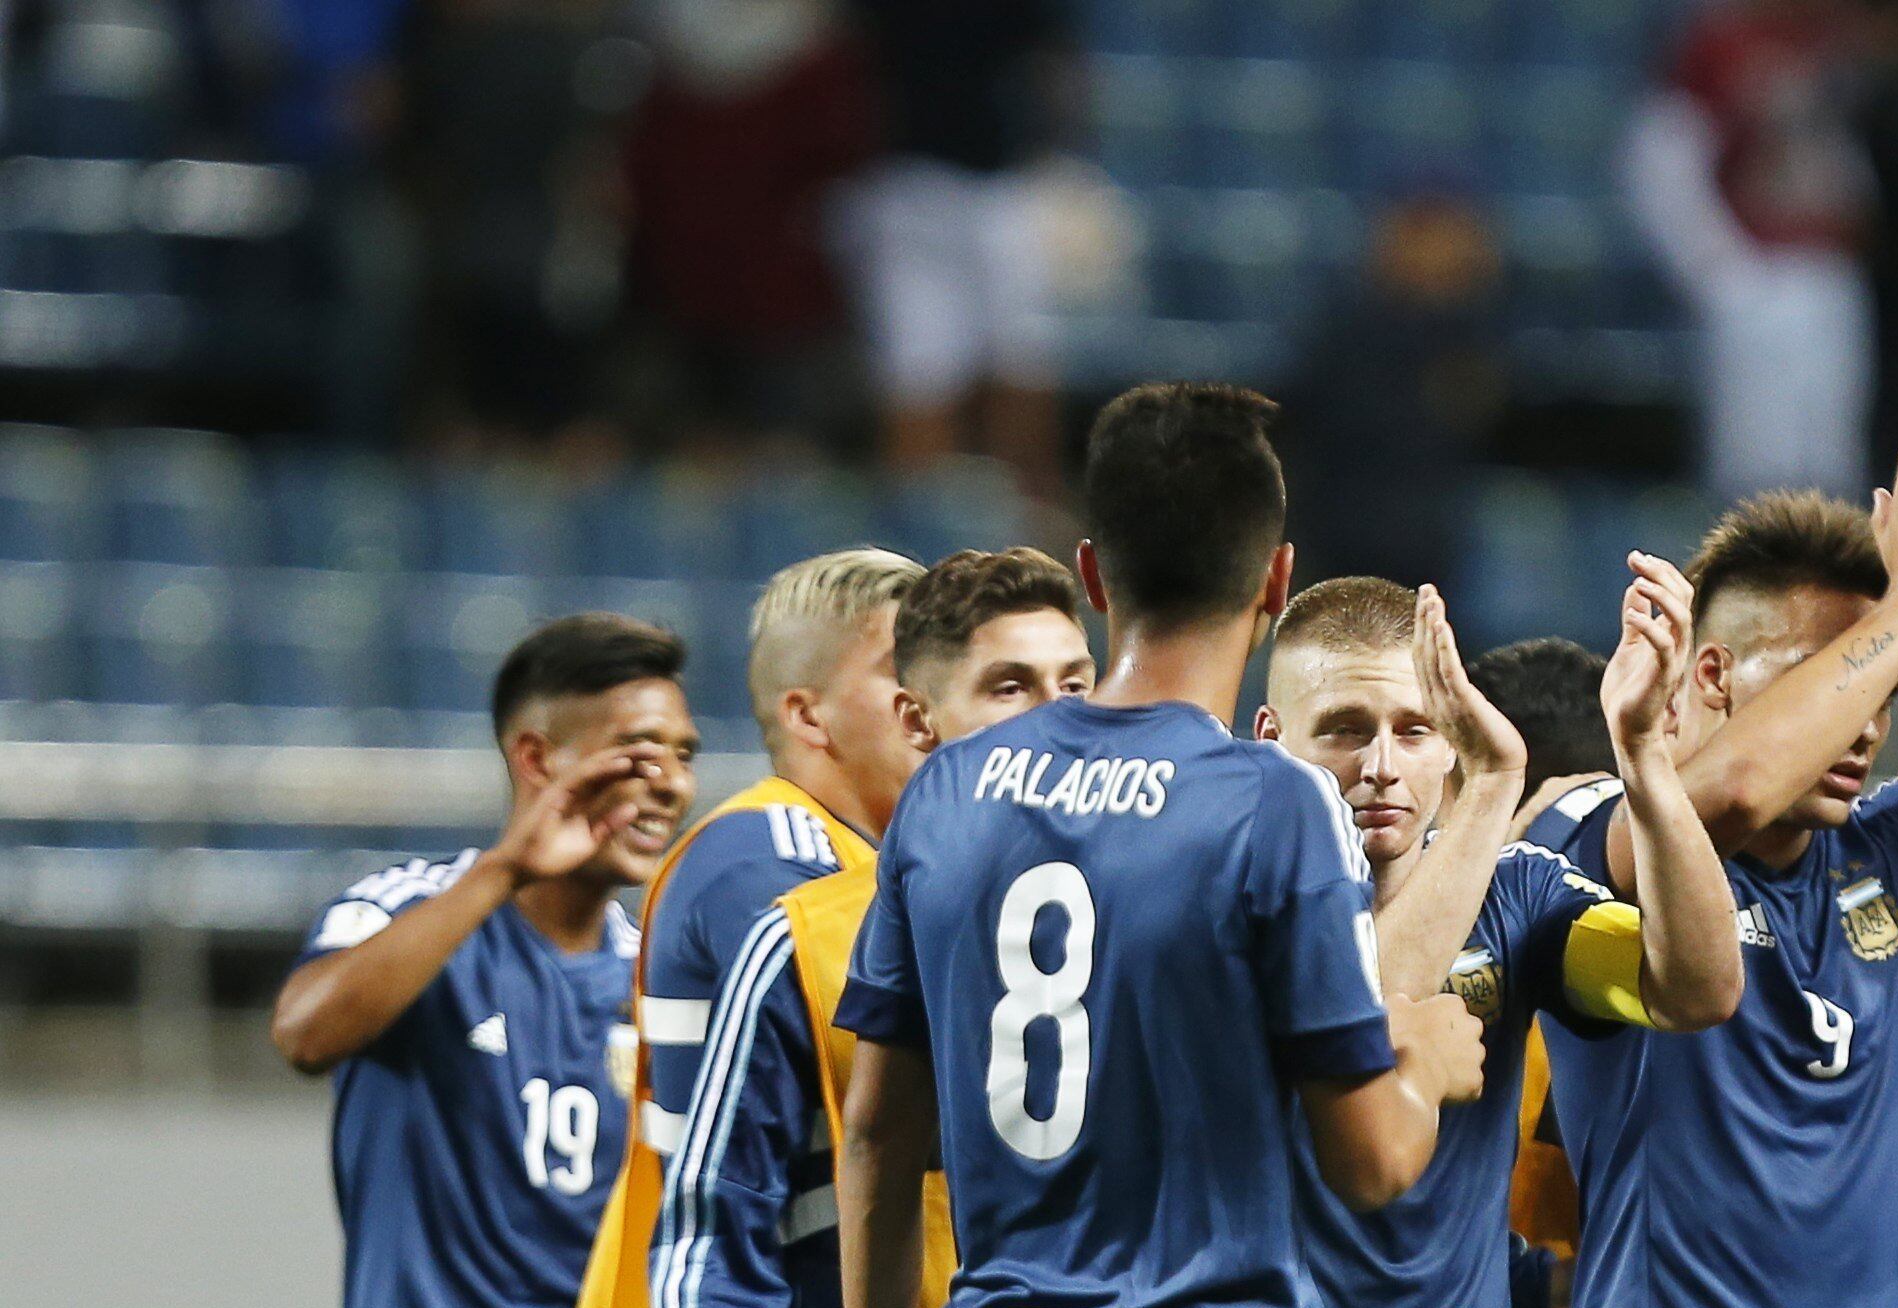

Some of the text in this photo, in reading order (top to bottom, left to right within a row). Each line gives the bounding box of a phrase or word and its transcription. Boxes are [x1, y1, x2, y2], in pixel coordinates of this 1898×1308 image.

[975, 746, 1176, 820] PALACIOS
[986, 861, 1096, 1161] 8
[1802, 990, 1854, 1079] 9
[519, 1077, 599, 1196] 19
